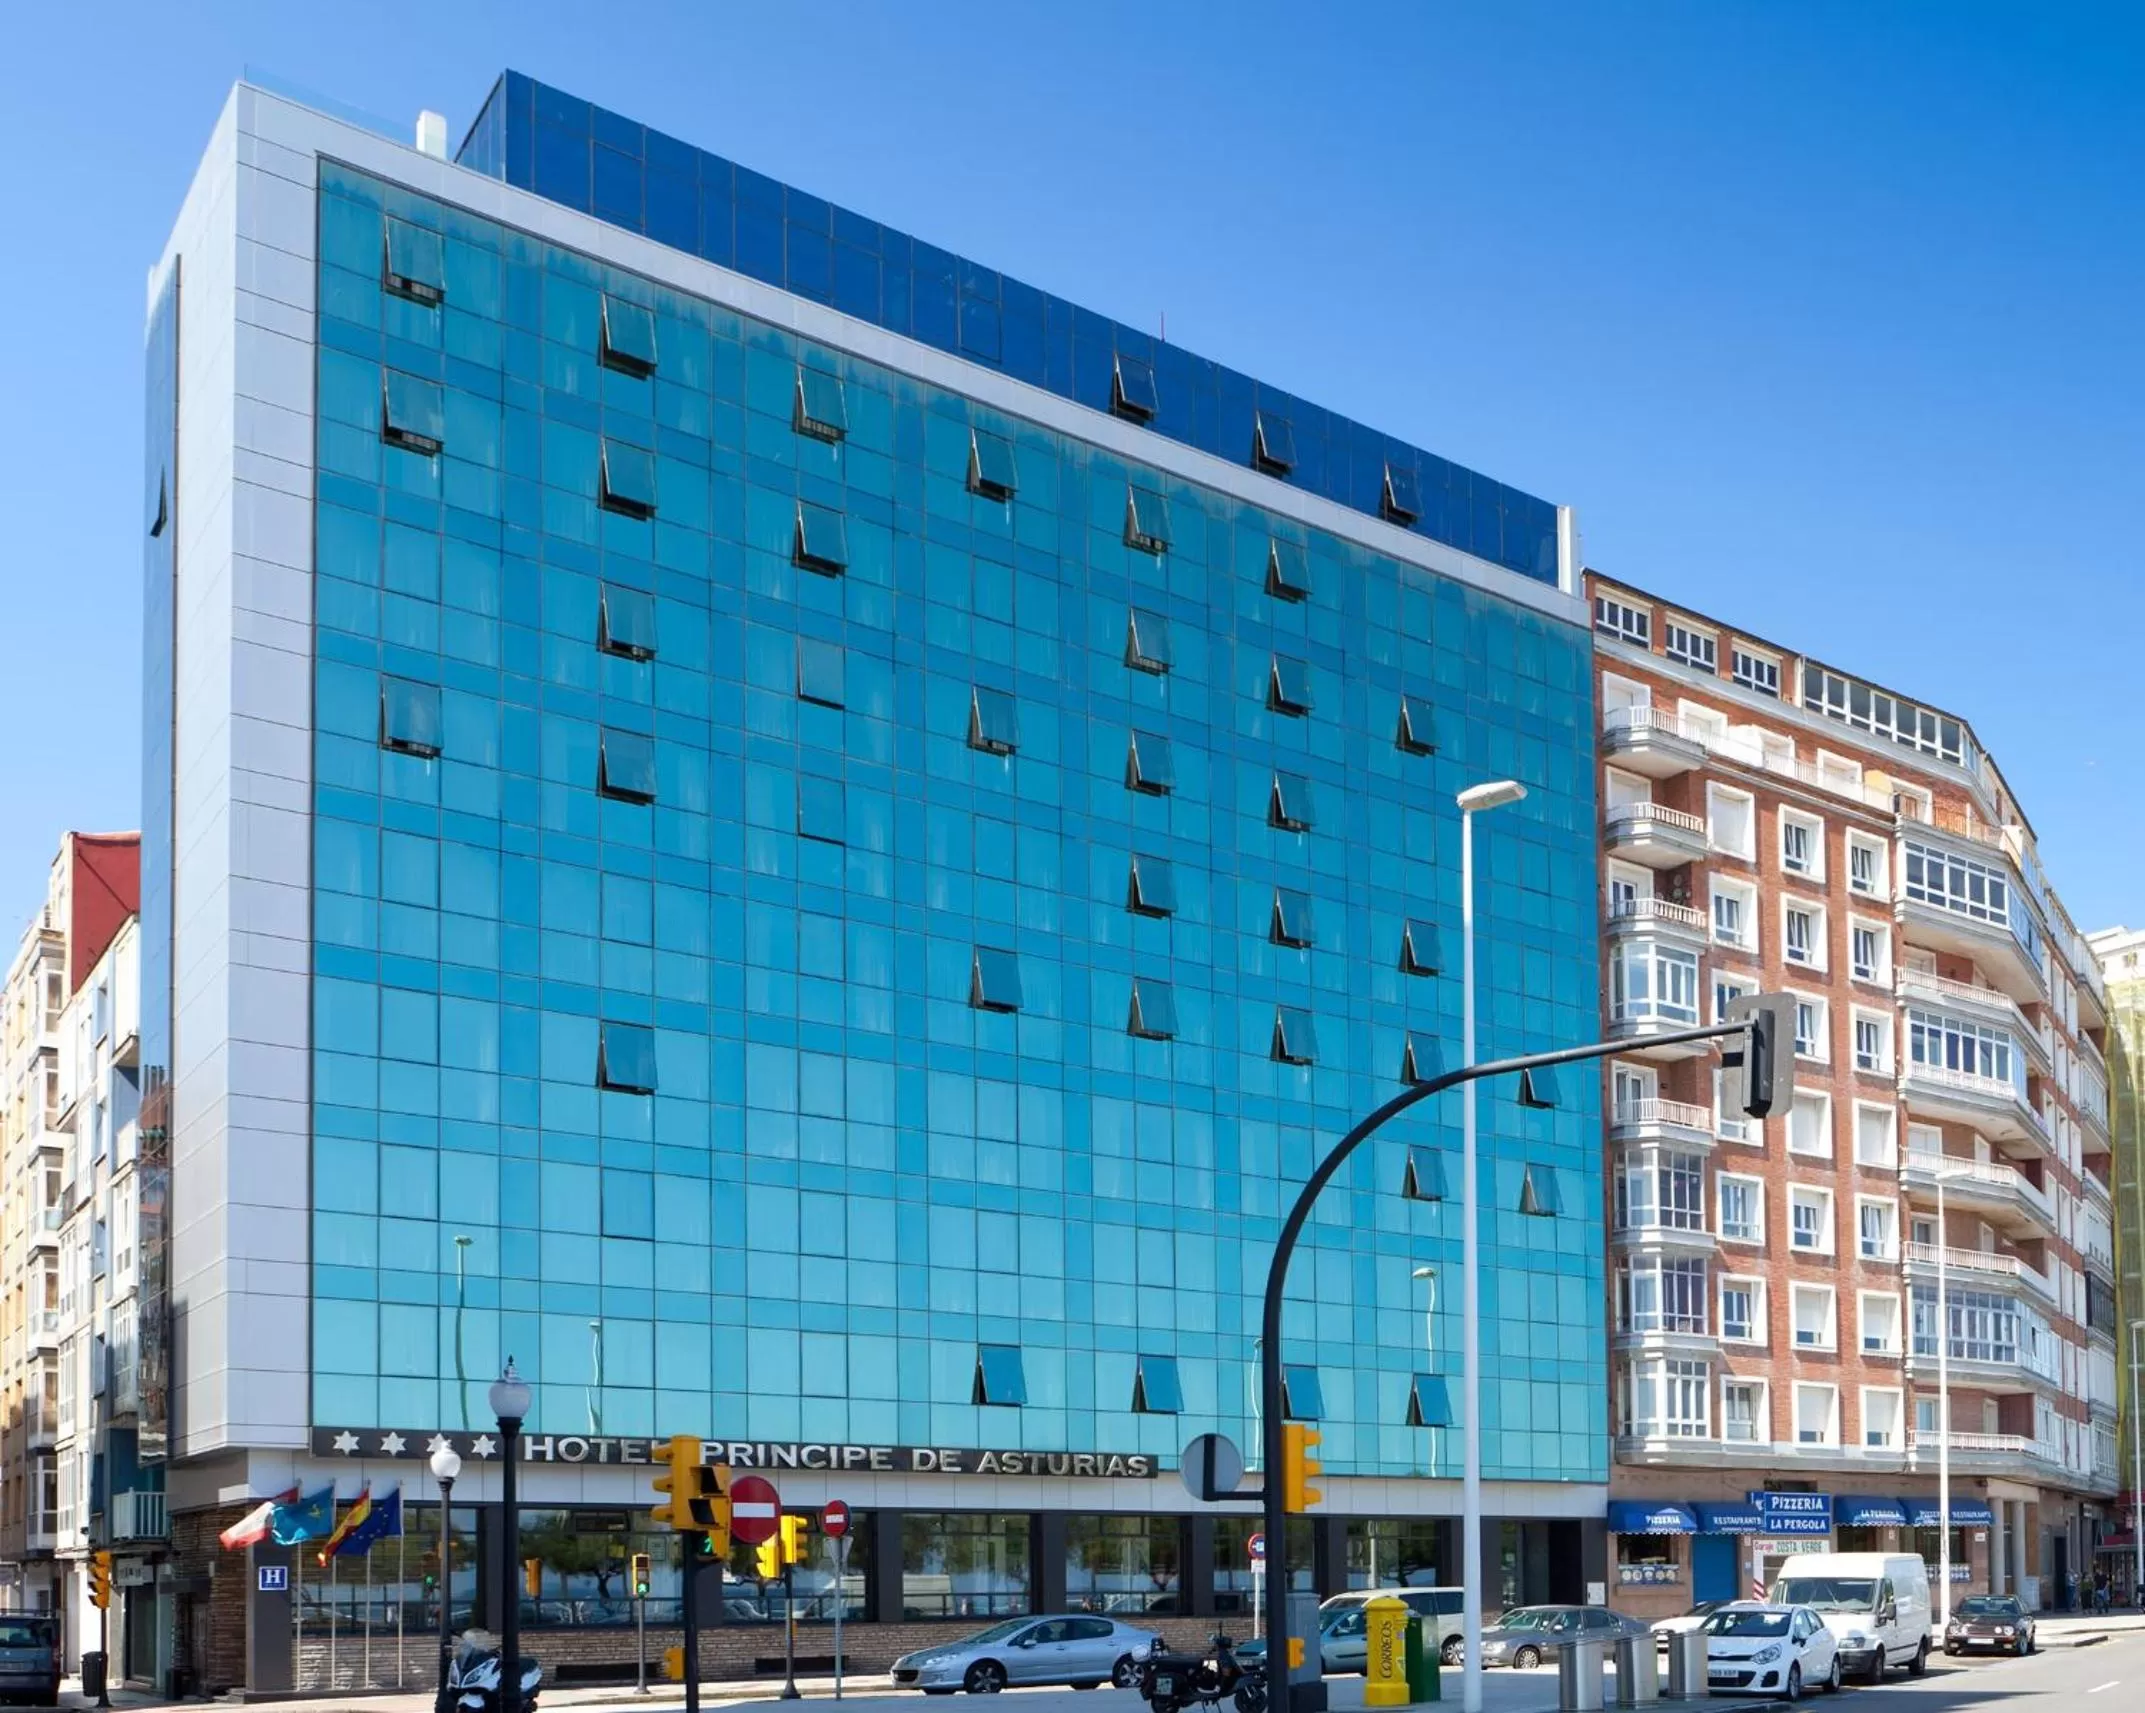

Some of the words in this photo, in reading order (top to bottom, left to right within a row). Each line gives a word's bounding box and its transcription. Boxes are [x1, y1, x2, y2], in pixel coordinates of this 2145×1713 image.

[701, 1442, 893, 1470] PRINCIPE
[912, 1448, 962, 1472] DE
[976, 1451, 1149, 1477] ASTURIAS
[1771, 1496, 1823, 1510] PIZZERIA
[1645, 1515, 1681, 1525] PIZZERIA
[1771, 1519, 1781, 1529] LA
[1784, 1519, 1826, 1530] PERGOLA
[1776, 1541, 1797, 1553] COSTA
[265, 1569, 281, 1584] H
[1381, 1620, 1393, 1678] CORREOS
